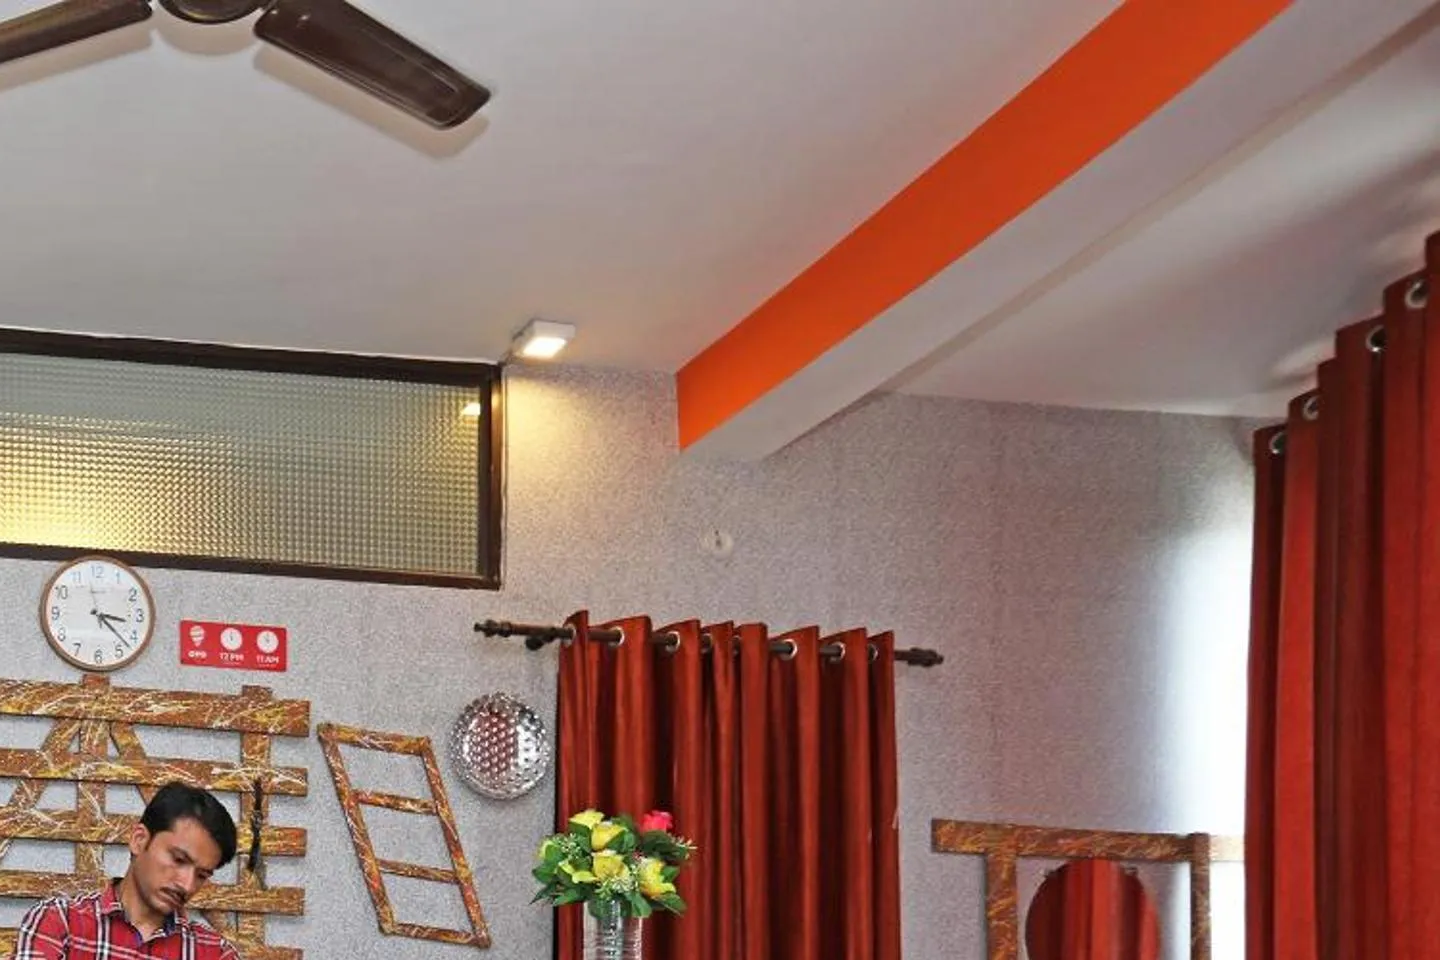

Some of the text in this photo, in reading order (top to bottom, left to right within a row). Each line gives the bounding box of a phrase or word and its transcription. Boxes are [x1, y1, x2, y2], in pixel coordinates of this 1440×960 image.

[90, 565, 104, 579] 12
[54, 585, 68, 600] 10
[128, 587, 137, 602] 2
[51, 605, 60, 620] 9
[135, 608, 144, 622] 3
[57, 627, 66, 642] 8
[129, 630, 138, 643] 4
[72, 642, 81, 656] 7
[94, 648, 103, 663] 6
[114, 643, 123, 658] 5
